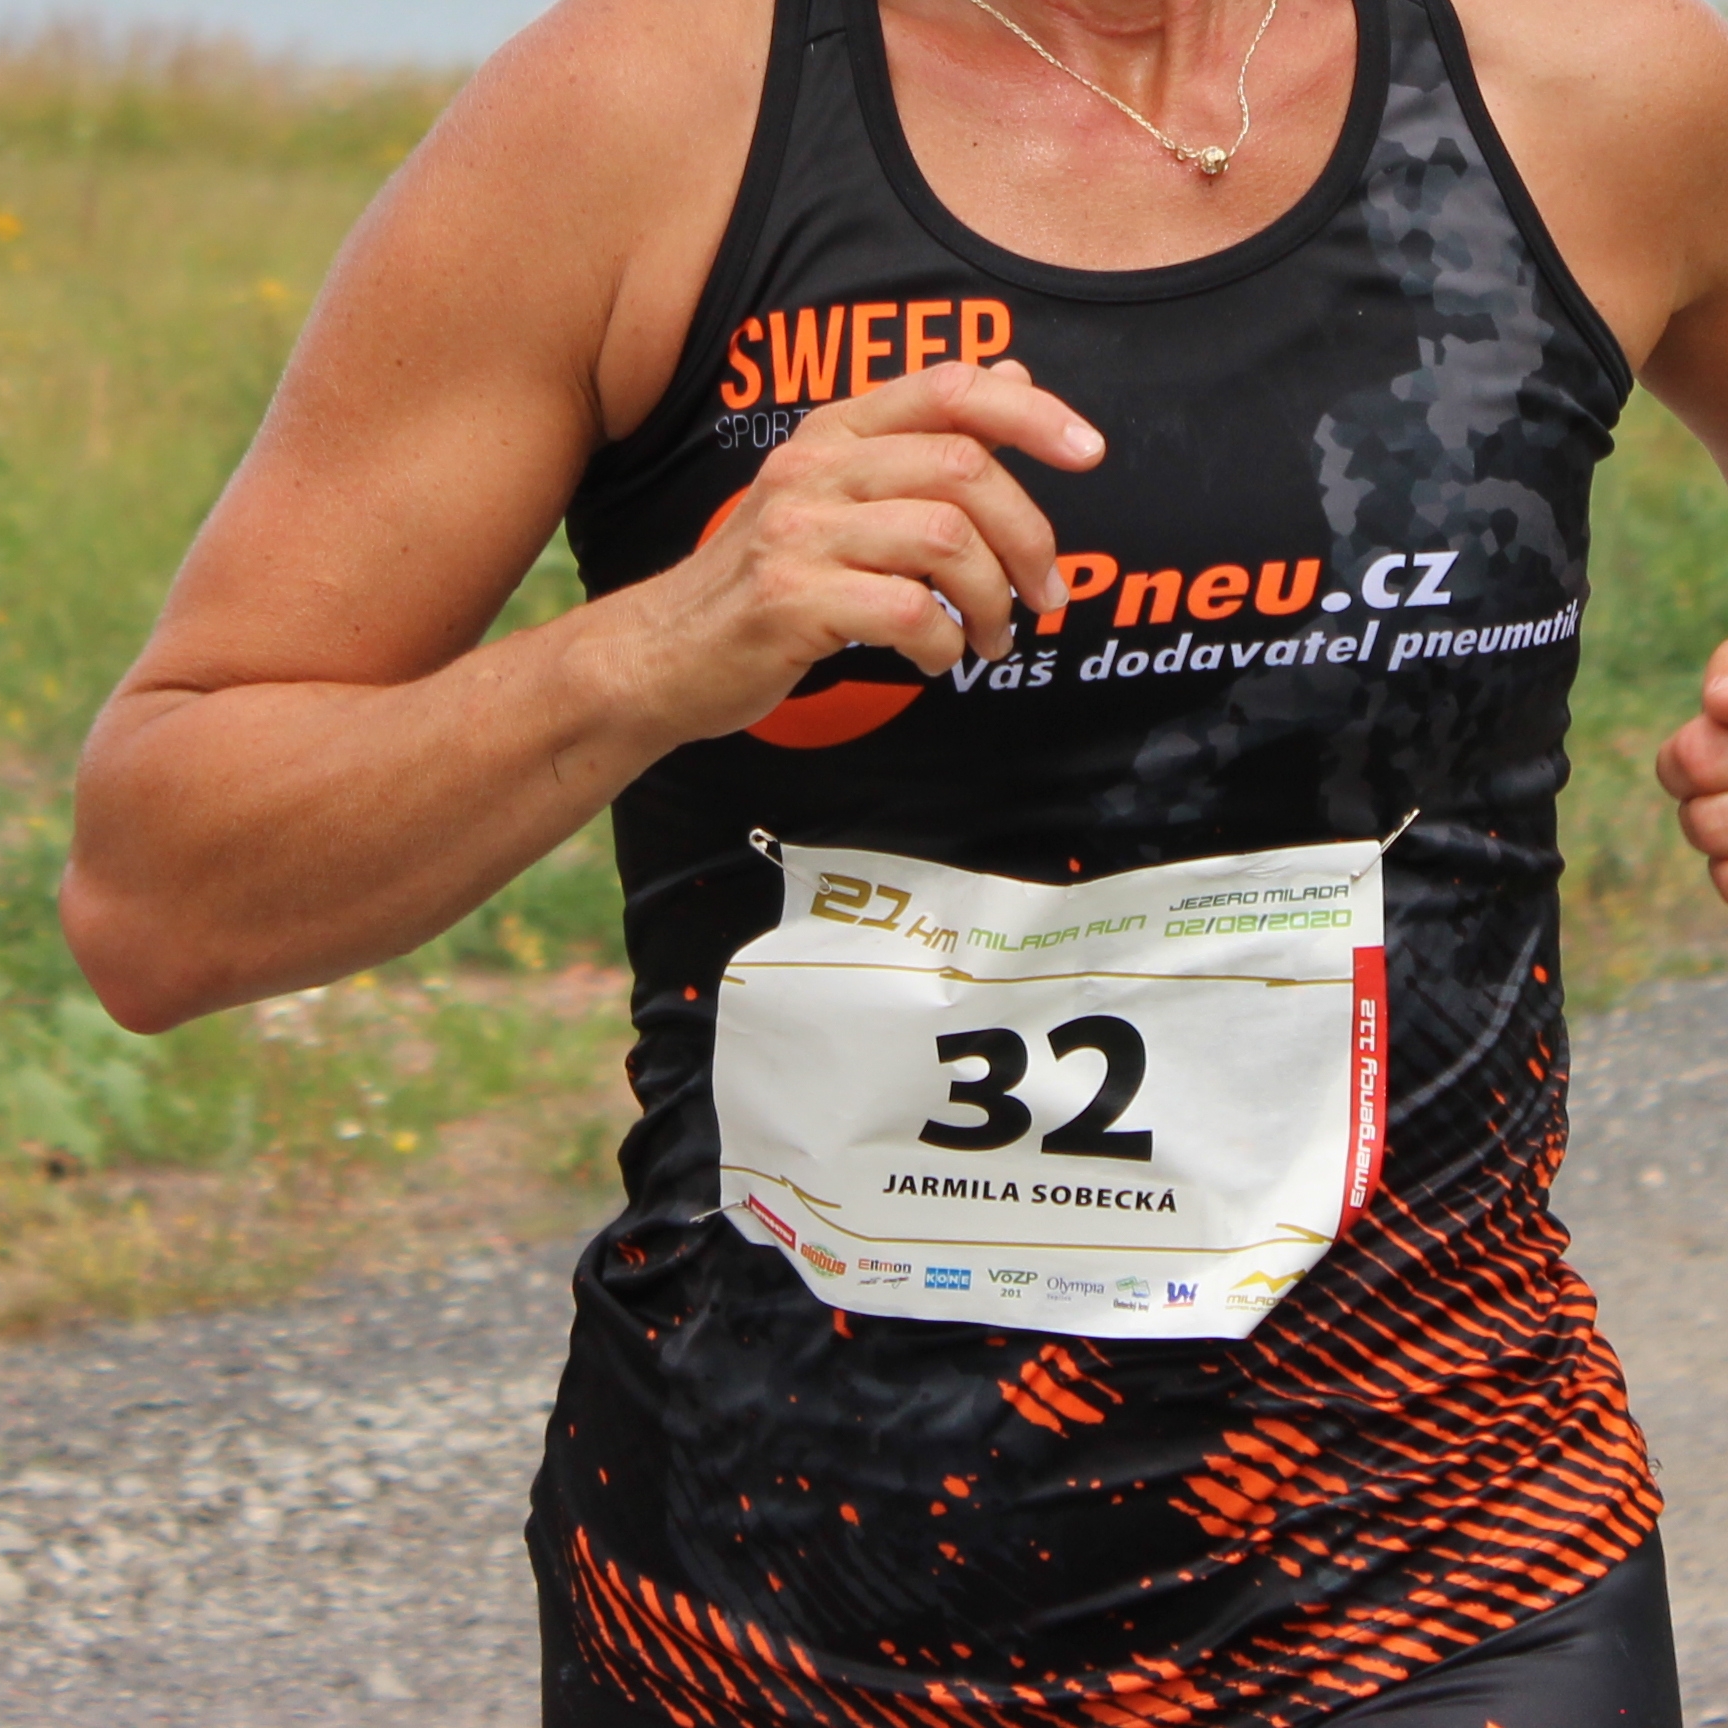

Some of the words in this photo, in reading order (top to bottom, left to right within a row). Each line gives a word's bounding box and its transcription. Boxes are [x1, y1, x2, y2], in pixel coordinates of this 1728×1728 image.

[720, 298, 1012, 410] SWEEP
[951, 650, 1058, 693] Váš
[1079, 620, 1380, 682] dodavatel
[1387, 598, 1579, 672] pneumatik
[810, 873, 912, 932] 21
[1169, 891, 1259, 912] JEZERO
[1263, 884, 1350, 904] MILADA
[967, 927, 1080, 952] MILADA
[1085, 915, 1148, 939] RUN
[1164, 909, 1353, 938] 02/08/2020
[1359, 999, 1377, 1052] 112
[918, 1014, 1154, 1163] 32
[1349, 1057, 1379, 1209] Emergency
[882, 1174, 1021, 1203] JARMILA
[1030, 1183, 1178, 1214] SOBECKÁ
[925, 1273, 970, 1286] KONE
[1000, 1288, 1022, 1299] 201
[1046, 1276, 1105, 1297] Olympia
